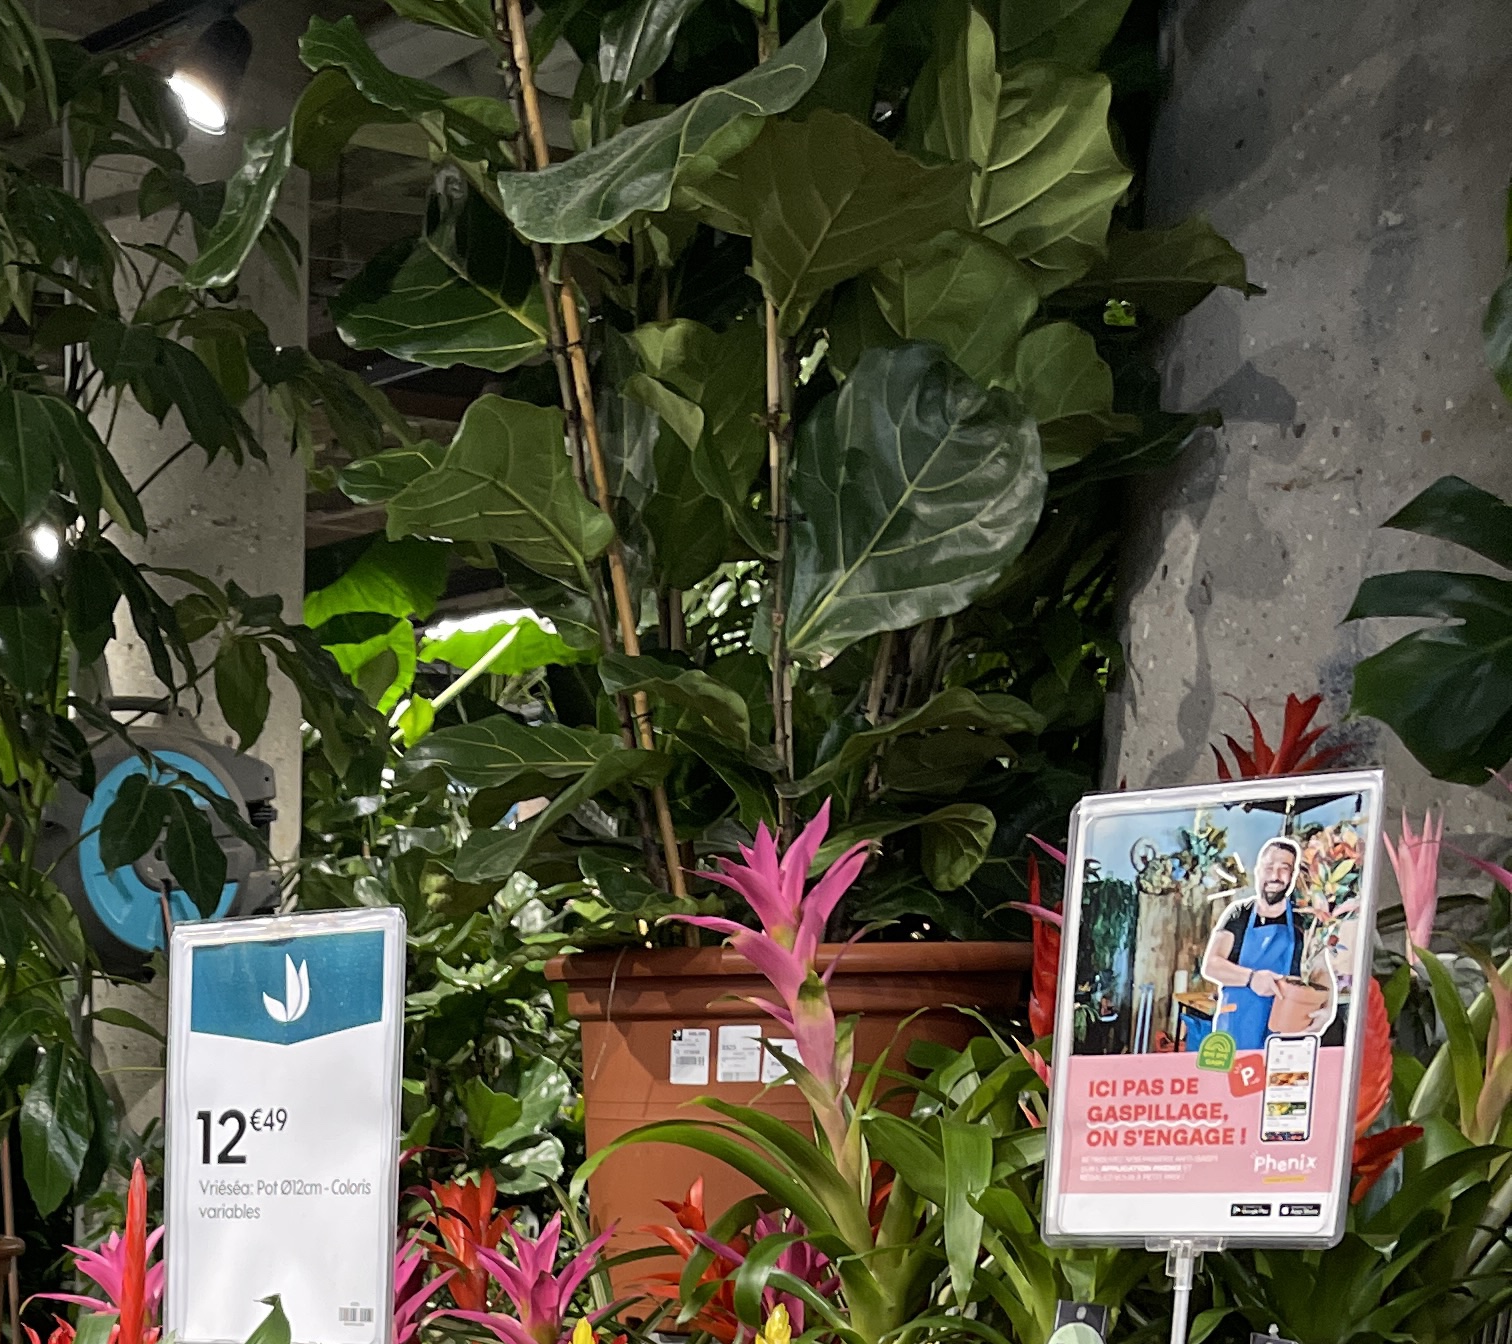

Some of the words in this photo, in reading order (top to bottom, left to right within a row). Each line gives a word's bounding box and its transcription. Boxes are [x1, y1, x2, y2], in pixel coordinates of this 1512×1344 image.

[1088, 1079, 1117, 1098] ICI
[1123, 1078, 1164, 1097] PAS
[1170, 1077, 1199, 1095] DE
[1087, 1102, 1229, 1122] GASPILLAGE,
[1086, 1130, 1118, 1147] ON
[1123, 1128, 1235, 1147] S'ENGAGE
[1253, 1153, 1318, 1174] Phenix
[199, 1180, 254, 1196] Vriéséa:
[257, 1179, 279, 1196] Pot
[331, 1178, 372, 1195] Coloris
[198, 1203, 261, 1220] variables
